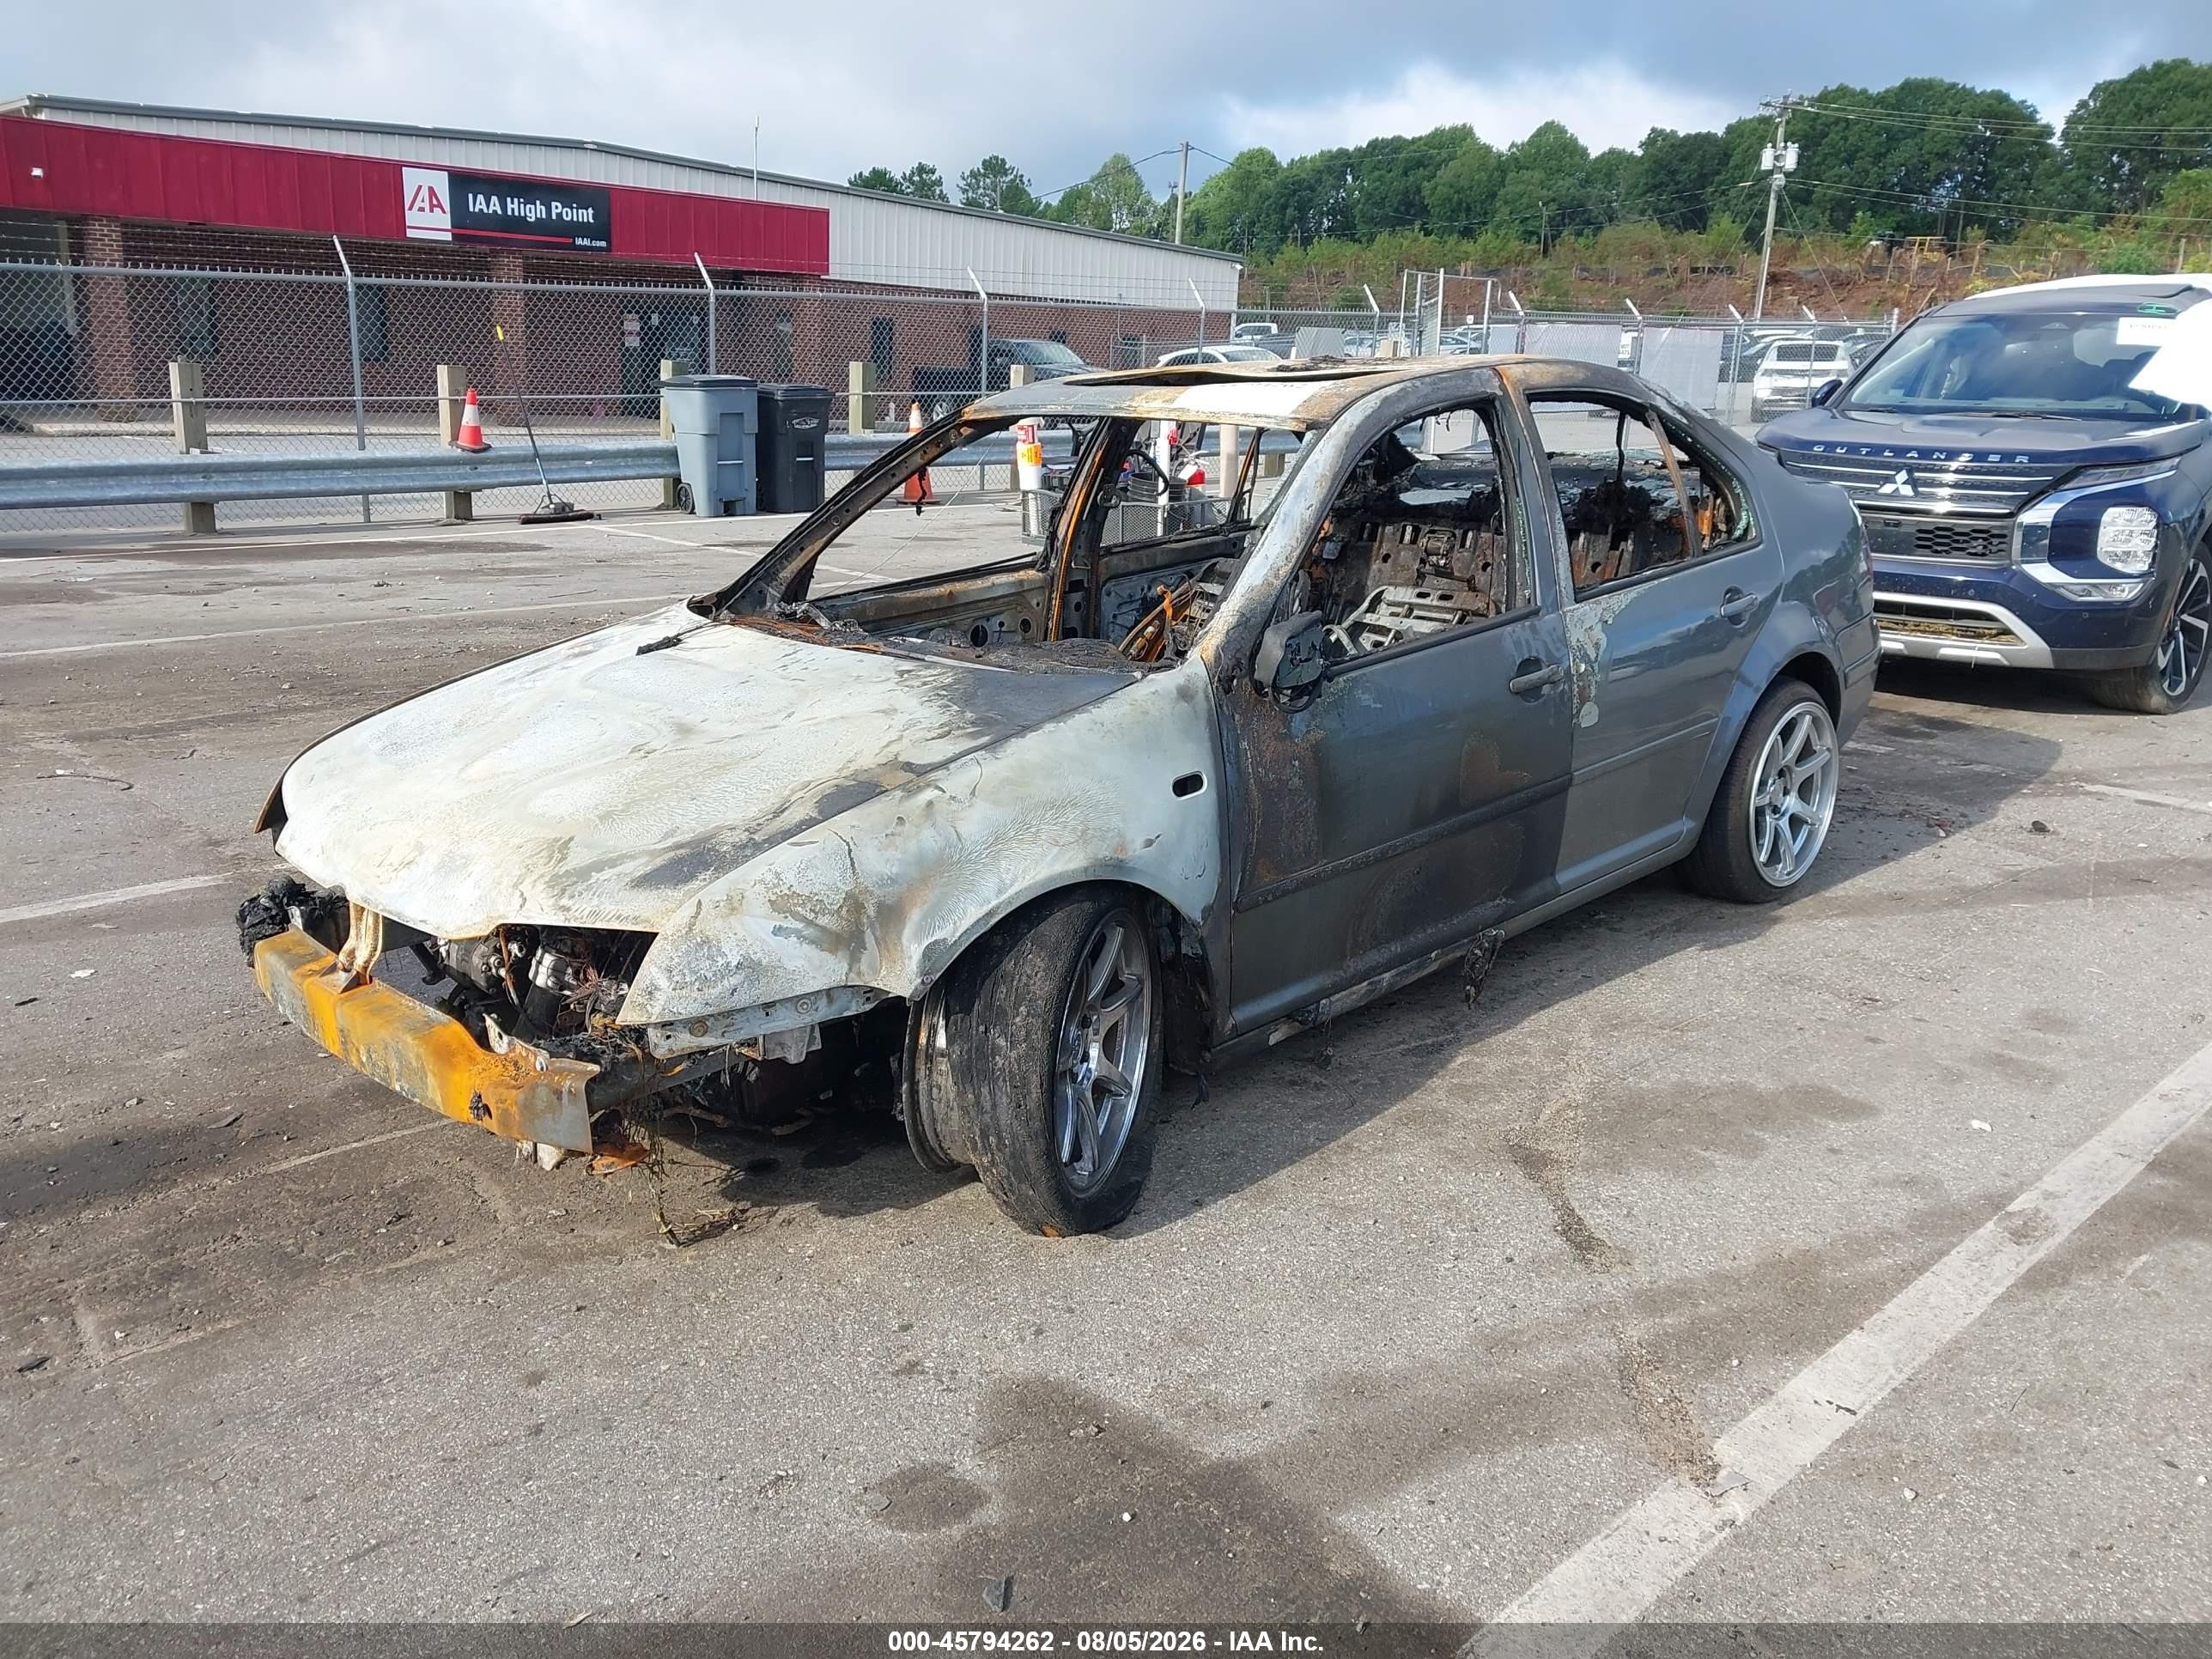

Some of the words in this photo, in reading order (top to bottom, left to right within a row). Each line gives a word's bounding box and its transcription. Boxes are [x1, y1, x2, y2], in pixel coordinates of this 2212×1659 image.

[468, 192, 502, 216] IAA
[507, 196, 546, 222] High
[551, 201, 595, 224] Point
[574, 236, 607, 248] IAAI.com
[1813, 444, 2031, 464] OUTLANDER
